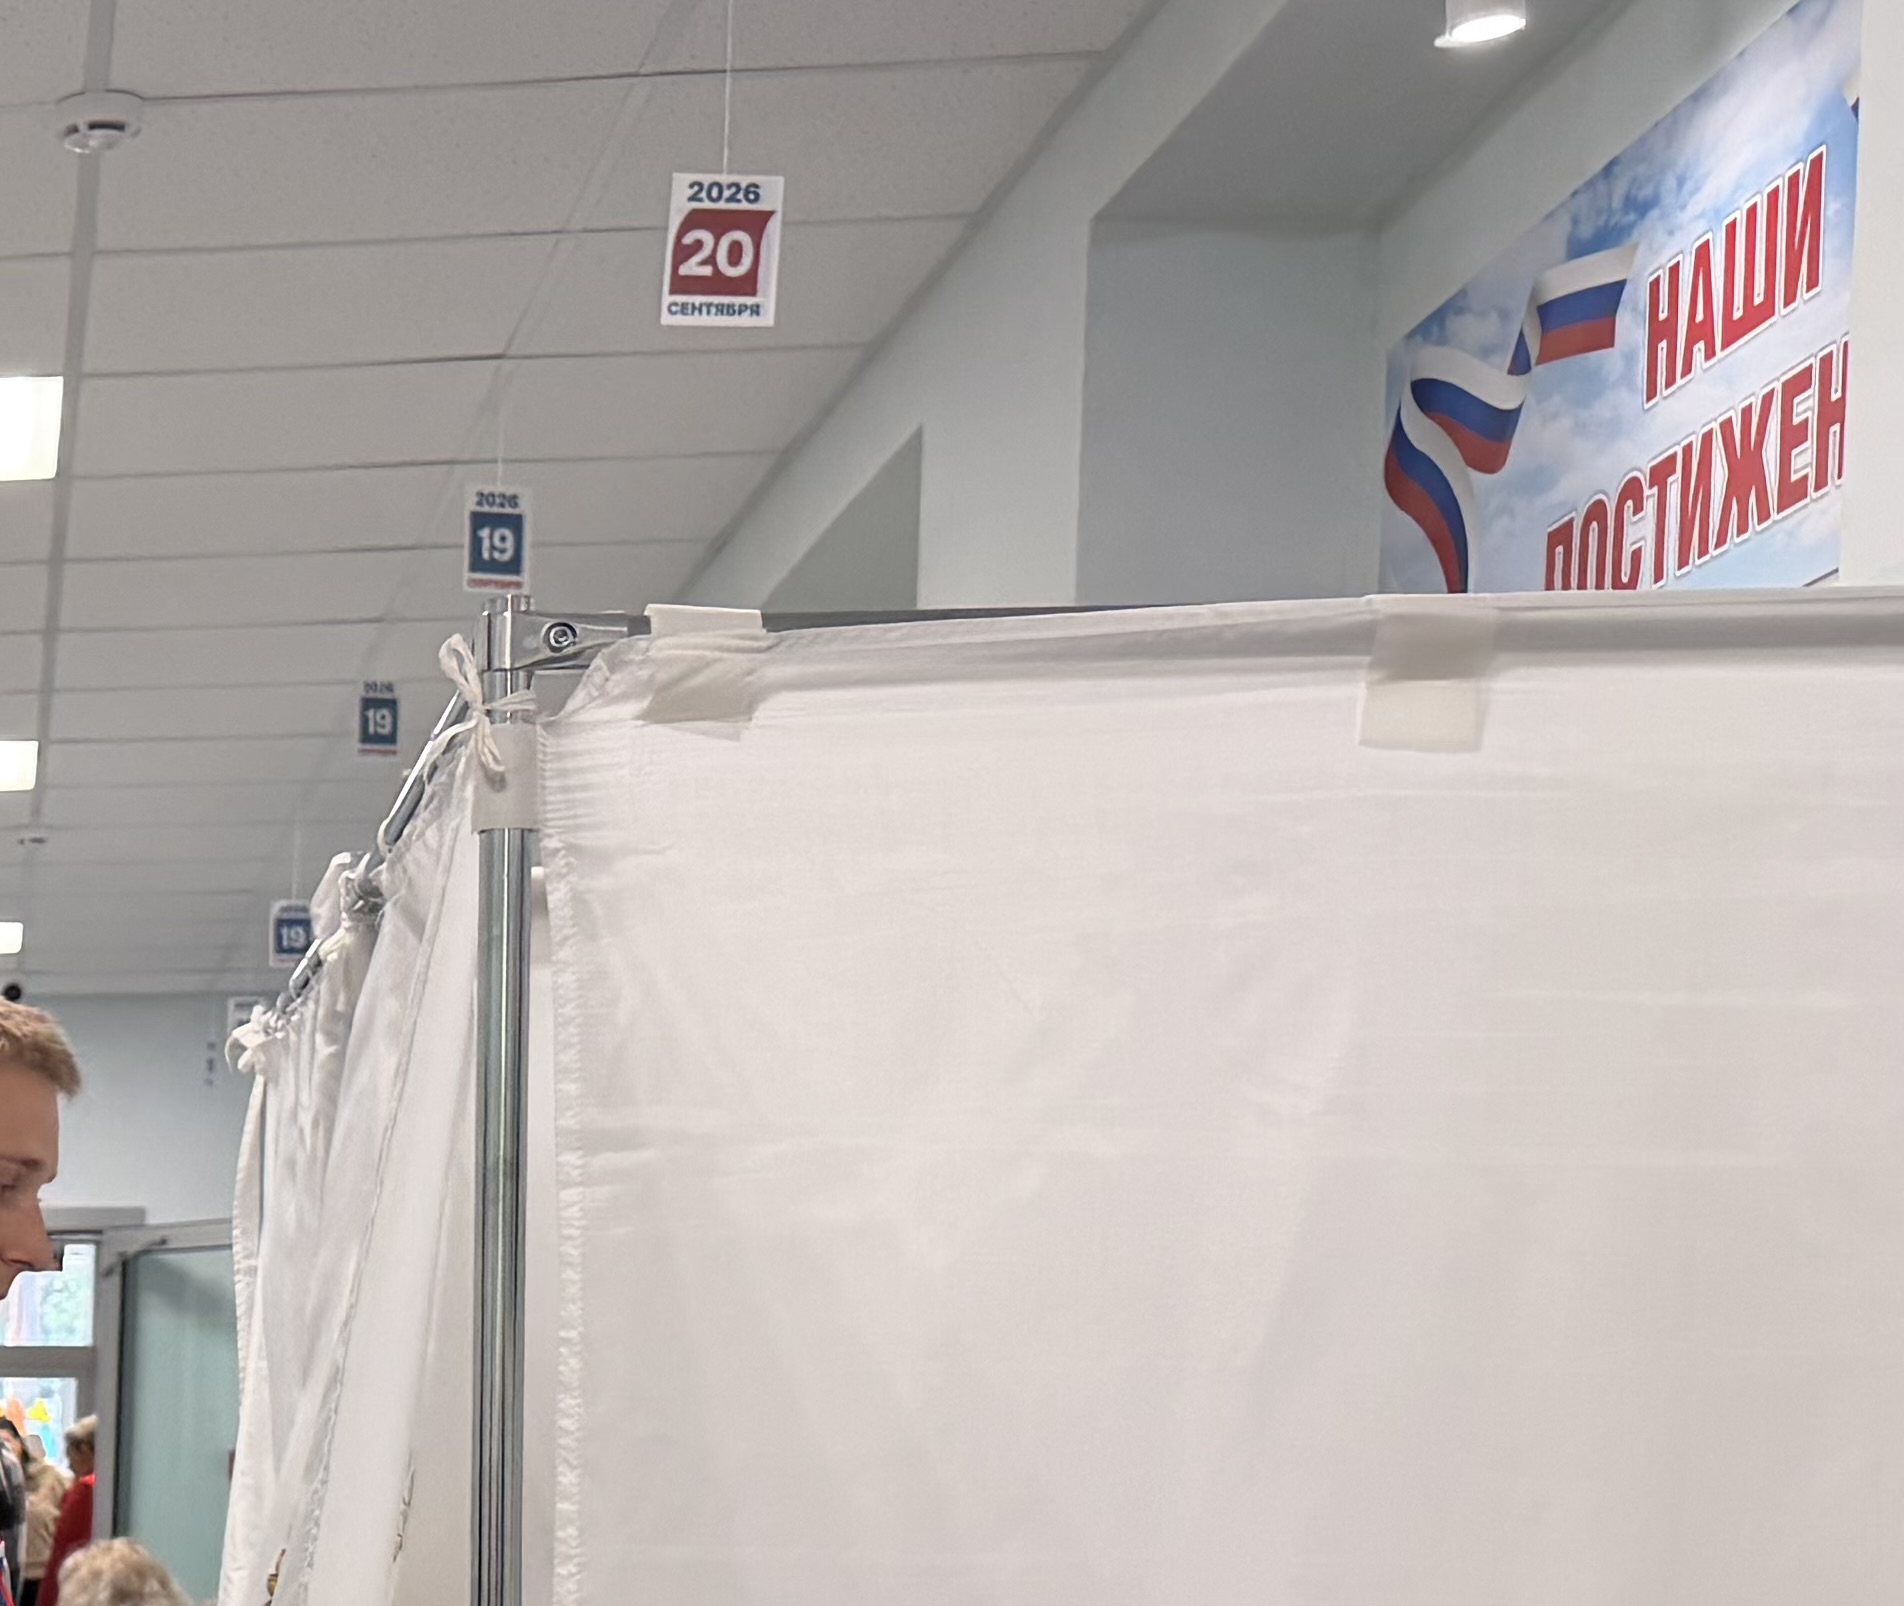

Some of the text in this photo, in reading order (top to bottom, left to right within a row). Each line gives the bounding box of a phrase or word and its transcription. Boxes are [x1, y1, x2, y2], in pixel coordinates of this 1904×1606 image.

[688, 181, 761, 204] 2026
[677, 229, 754, 278] 20
[1642, 144, 1826, 411] НАШИ
[667, 302, 761, 317] СЕНТЯБРЯ
[476, 491, 520, 509] 2026
[476, 527, 514, 562] 19
[364, 708, 392, 736] 19
[280, 925, 306, 950] 19
